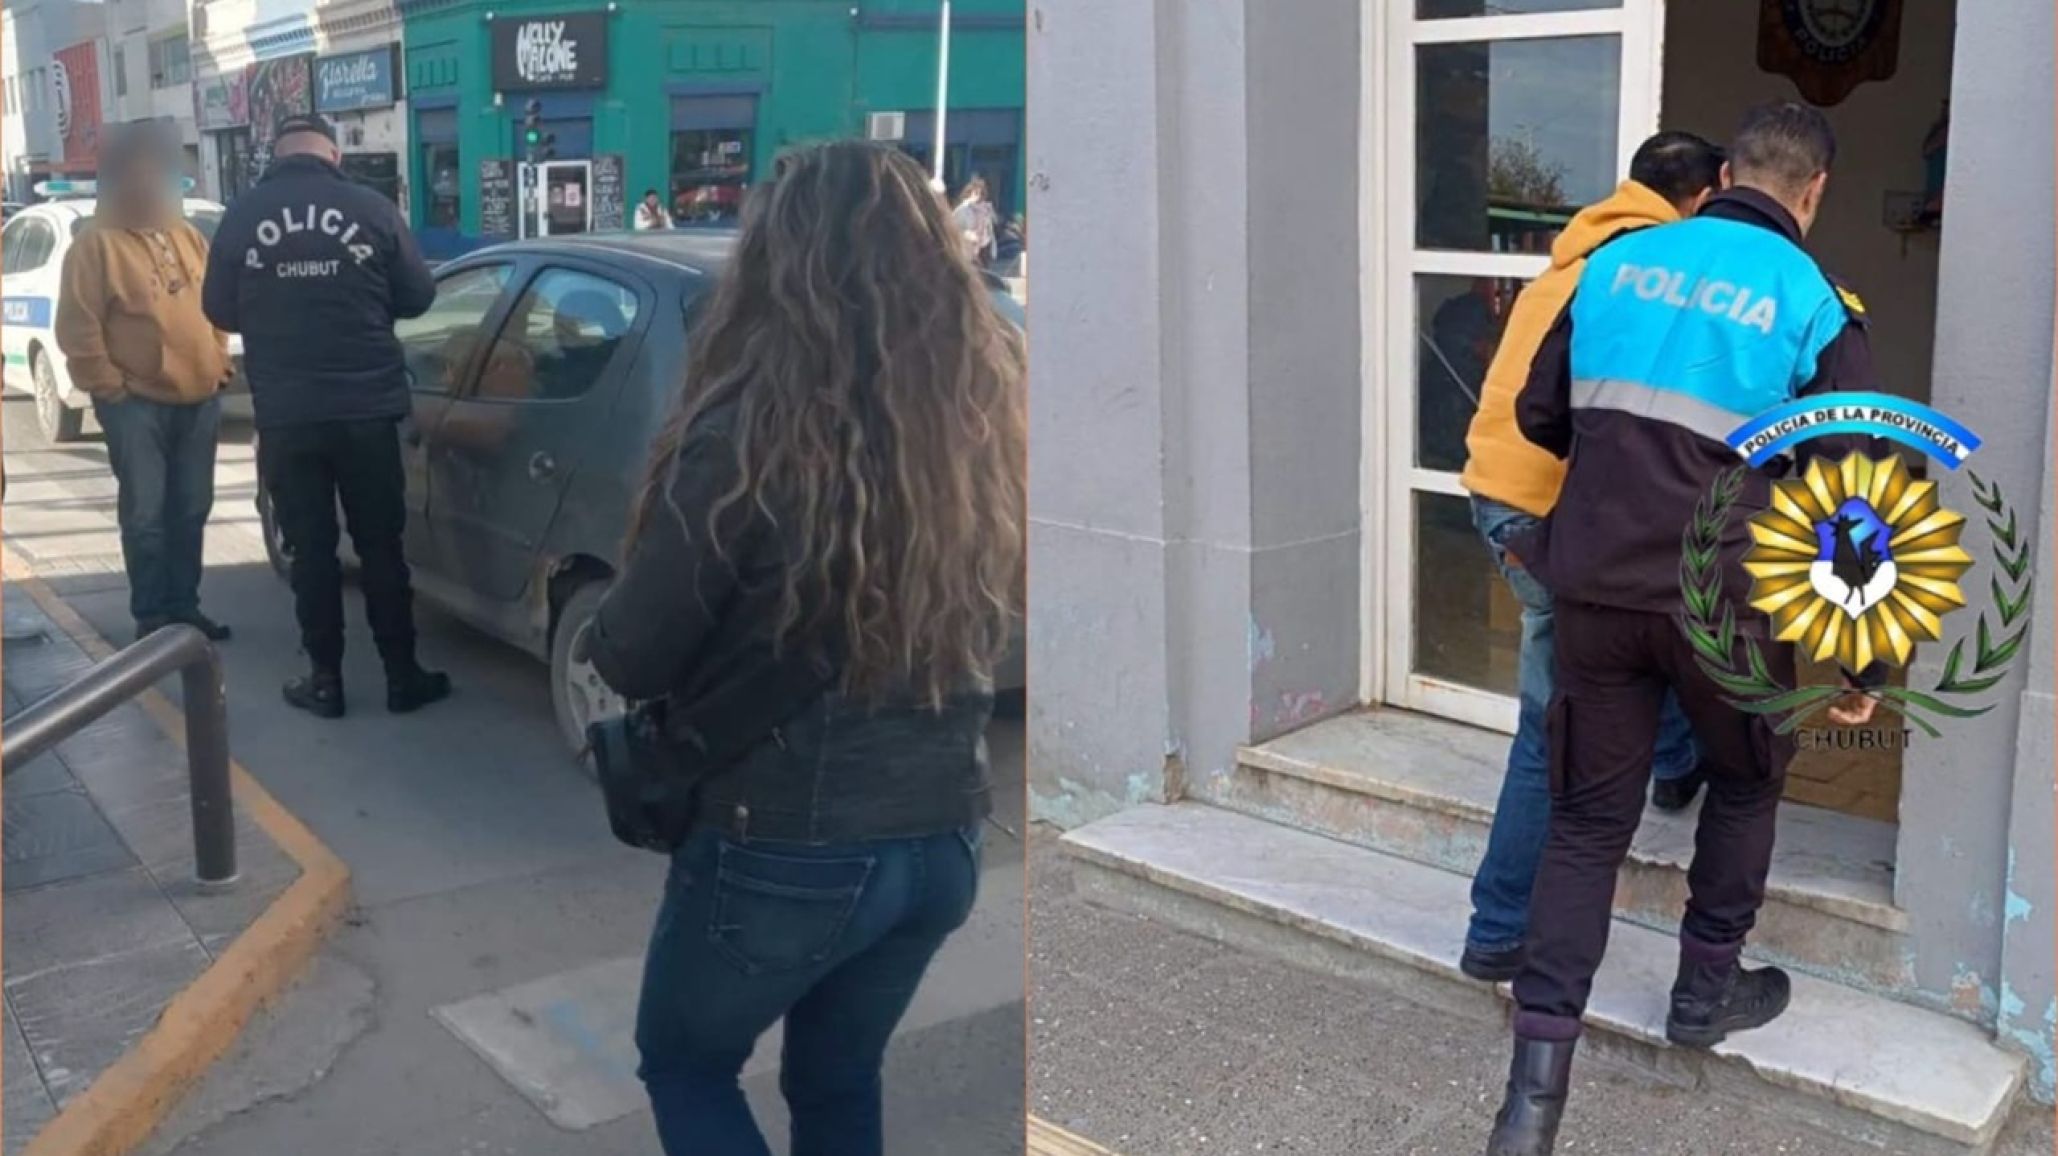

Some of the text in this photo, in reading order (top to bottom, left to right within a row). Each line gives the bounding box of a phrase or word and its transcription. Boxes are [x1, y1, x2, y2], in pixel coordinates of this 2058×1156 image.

[245, 204, 374, 269] POLICIA
[276, 260, 340, 278] CHUBUT
[1611, 263, 1776, 335] POLICIA
